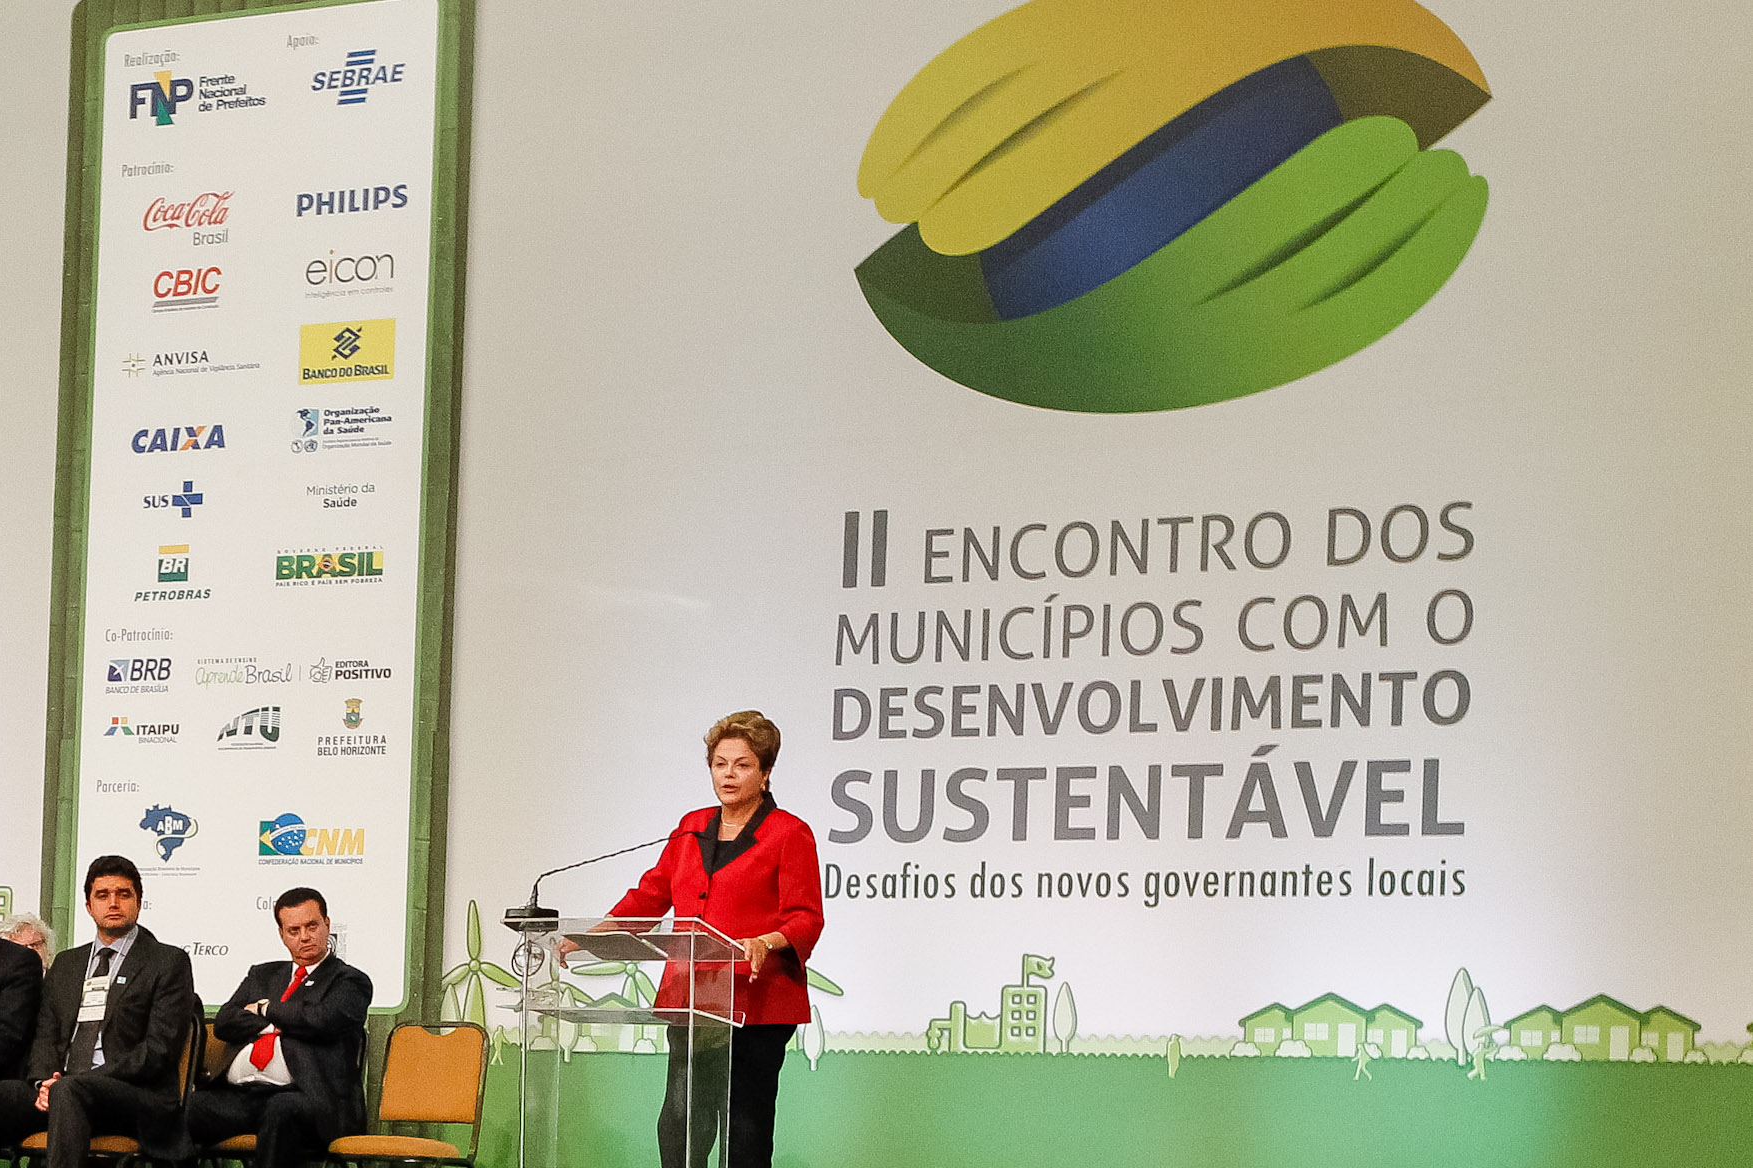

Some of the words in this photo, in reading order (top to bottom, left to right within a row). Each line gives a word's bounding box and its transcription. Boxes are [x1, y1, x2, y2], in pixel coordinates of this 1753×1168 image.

[287, 34, 319, 50] Apoio:
[124, 49, 180, 67] Realização:
[199, 74, 235, 87] Frente
[310, 63, 406, 91] SEBRAE
[129, 78, 194, 120] FNP
[198, 84, 247, 100] Nacional
[198, 102, 212, 112] de
[216, 96, 266, 110] Prefeitos
[121, 161, 174, 177] Patrocínio:
[296, 184, 408, 217] PHILIPS
[192, 228, 228, 246] Brasil
[305, 249, 394, 285] eicon
[153, 267, 222, 298] CBIC
[152, 351, 209, 367] ANVISA
[302, 368, 338, 380] BANCO
[339, 366, 353, 377] DO
[354, 364, 390, 377] BRASIL
[323, 406, 379, 418] Organização
[323, 415, 392, 426] Pan-Americana
[323, 427, 334, 435] da
[337, 425, 365, 434] Saúde
[131, 424, 225, 454] CAIXA
[306, 483, 359, 496] Ministério
[361, 482, 375, 493] da
[143, 495, 169, 508] SUS
[323, 497, 357, 508] Saúde
[841, 509, 889, 588] II
[923, 511, 1292, 585] ENCONTRO
[1326, 501, 1477, 566] DOS
[160, 558, 186, 573] BR
[276, 551, 383, 580] BRASIL
[134, 588, 211, 601] PETROBRAS
[104, 628, 174, 642] Co-Patrocínio:
[834, 593, 1204, 666] MUNICÍPIOS
[1237, 591, 1389, 652] COM
[1426, 588, 1474, 645] O
[129, 658, 172, 681] BRB
[335, 660, 369, 668] EDITORA
[335, 668, 392, 680] POSITIVO
[105, 686, 129, 694] BANCO
[831, 669, 1472, 742] DESENVOLVIMENTO
[136, 724, 180, 736] ITAIPU
[138, 736, 177, 744] BINACIONAL
[318, 735, 387, 746] PREFEITURA
[317, 746, 338, 756] BELO
[340, 745, 387, 755] HORIZONTE
[96, 780, 140, 793] Parceria:
[827, 744, 1466, 844] SUSTENTÁVEL
[156, 815, 183, 835] ABM
[299, 828, 365, 856] CNM
[824, 861, 957, 901] Desafios
[969, 862, 1024, 900] dos
[1036, 868, 1131, 900] novos
[1143, 862, 1353, 908] governantes
[1367, 858, 1466, 899] locais
[193, 941, 229, 955] TERCO
